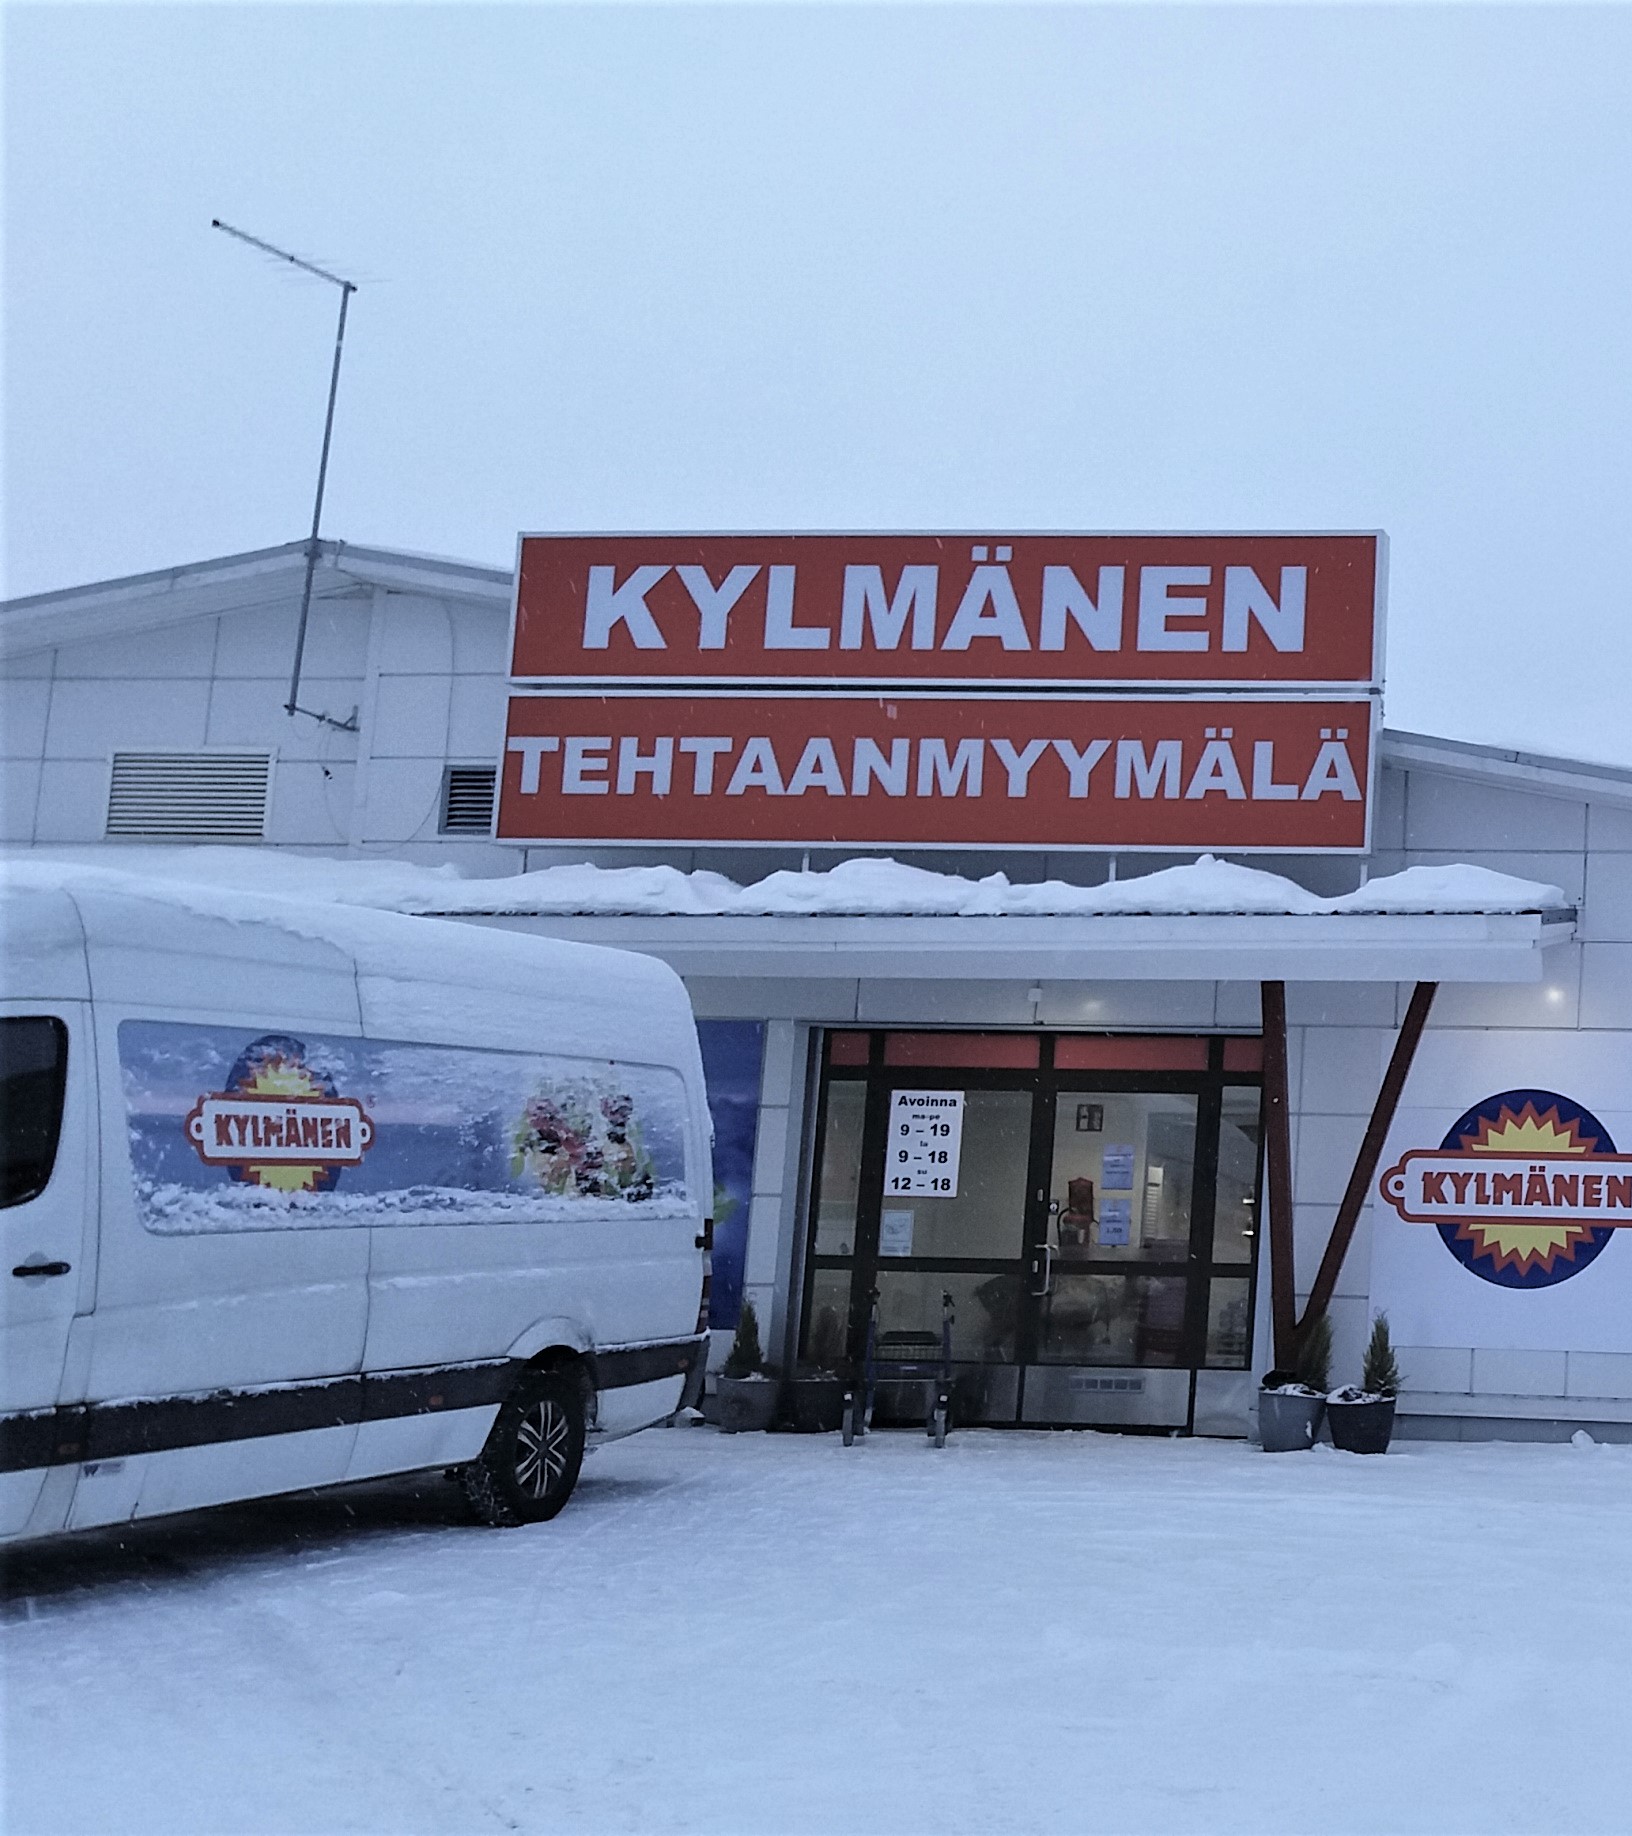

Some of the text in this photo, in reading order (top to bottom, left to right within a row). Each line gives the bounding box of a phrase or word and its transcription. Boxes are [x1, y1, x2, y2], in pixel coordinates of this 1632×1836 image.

[580, 544, 1308, 655] KYLMÄNEN
[506, 727, 1364, 802] TEHTAANMYYMÄLÄ
[898, 1095, 957, 1108] Avoinna
[214, 1108, 352, 1149] KYLMÄNEN
[900, 1123, 910, 1137] 9
[930, 1123, 951, 1137] 19
[898, 1150, 909, 1163] 9
[928, 1150, 948, 1164] 18
[891, 1177, 911, 1190] 12
[930, 1178, 951, 1191] 18
